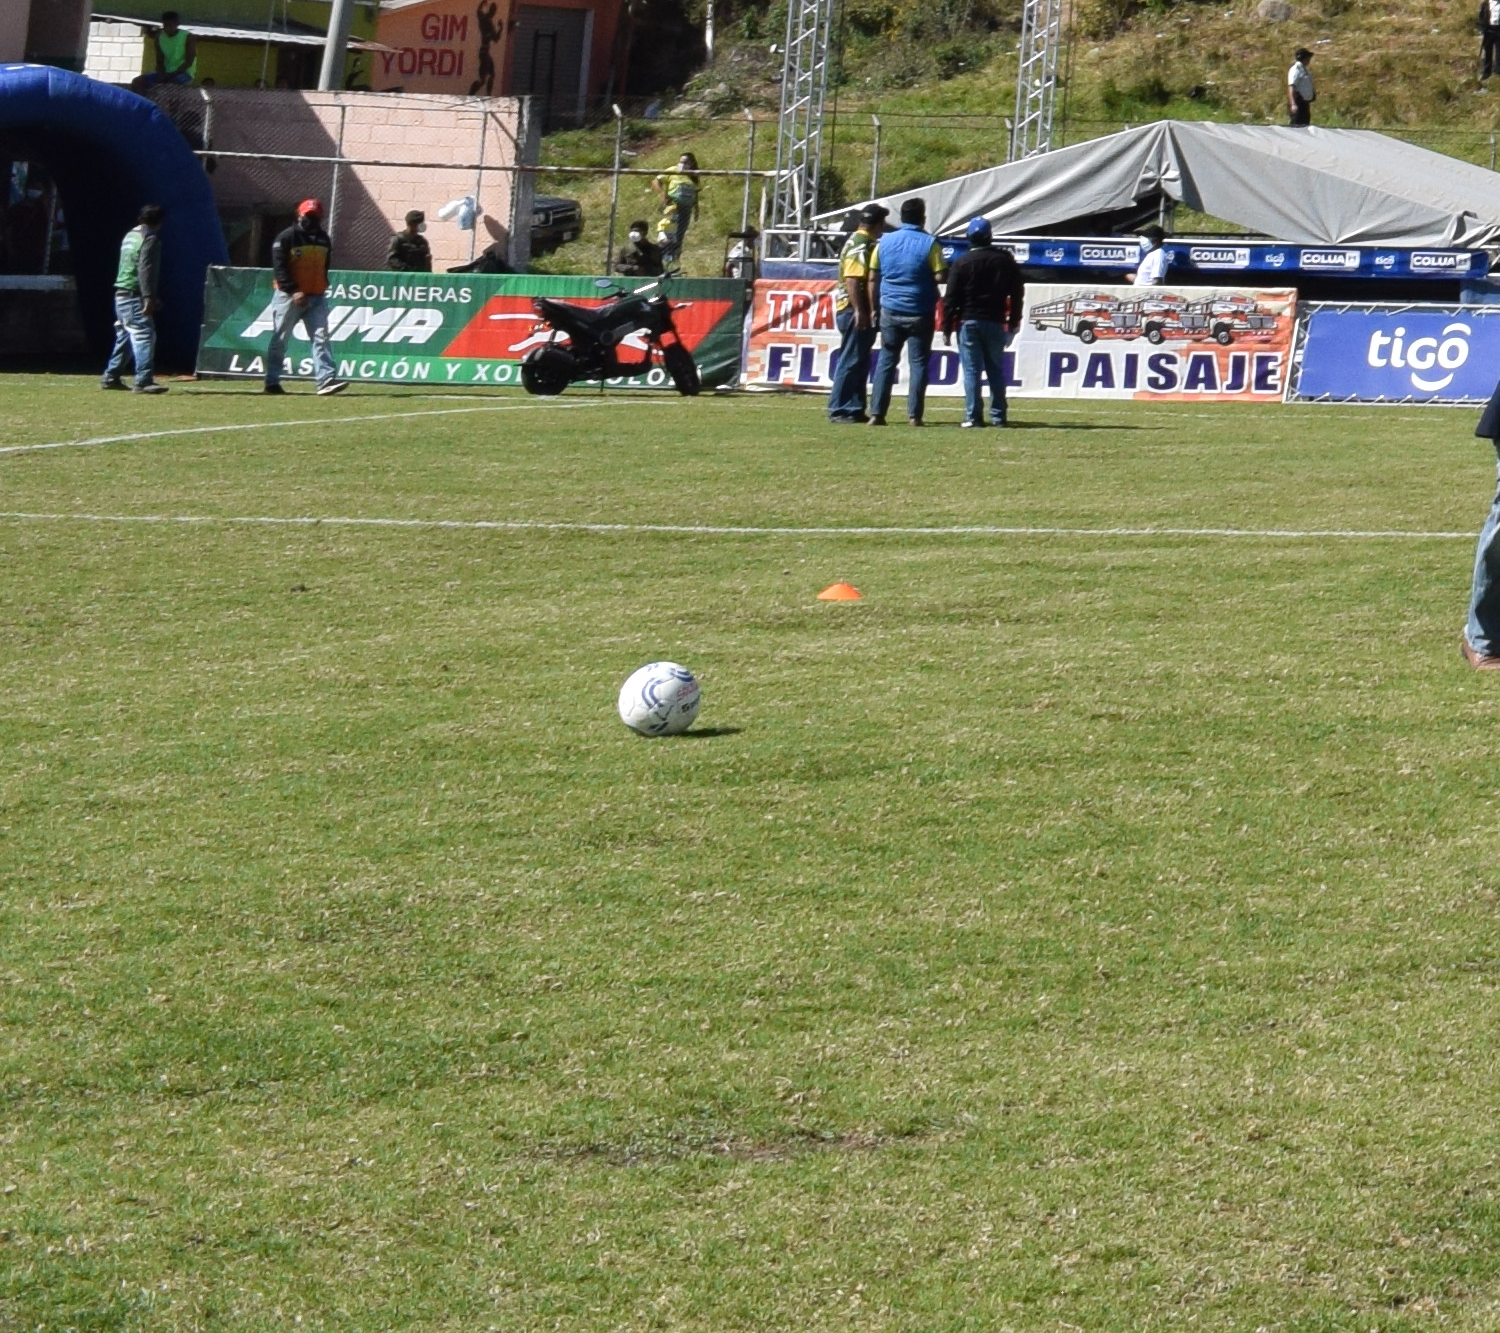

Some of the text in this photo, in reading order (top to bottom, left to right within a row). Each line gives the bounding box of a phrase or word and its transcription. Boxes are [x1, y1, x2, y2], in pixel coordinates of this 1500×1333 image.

[421, 13, 469, 42] GIM
[379, 47, 464, 76] YORDI
[1082, 249, 1126, 260] COLUA
[1192, 250, 1235, 262] COLUA
[1302, 252, 1345, 264] COLUA
[1413, 255, 1456, 266] COLUA
[1367, 322, 1473, 370] tigo
[229, 354, 264, 372] LA
[282, 356, 431, 380] ASNCIÓN
[444, 363, 461, 379] Y
[1050, 351, 1283, 393] PAISAJE
